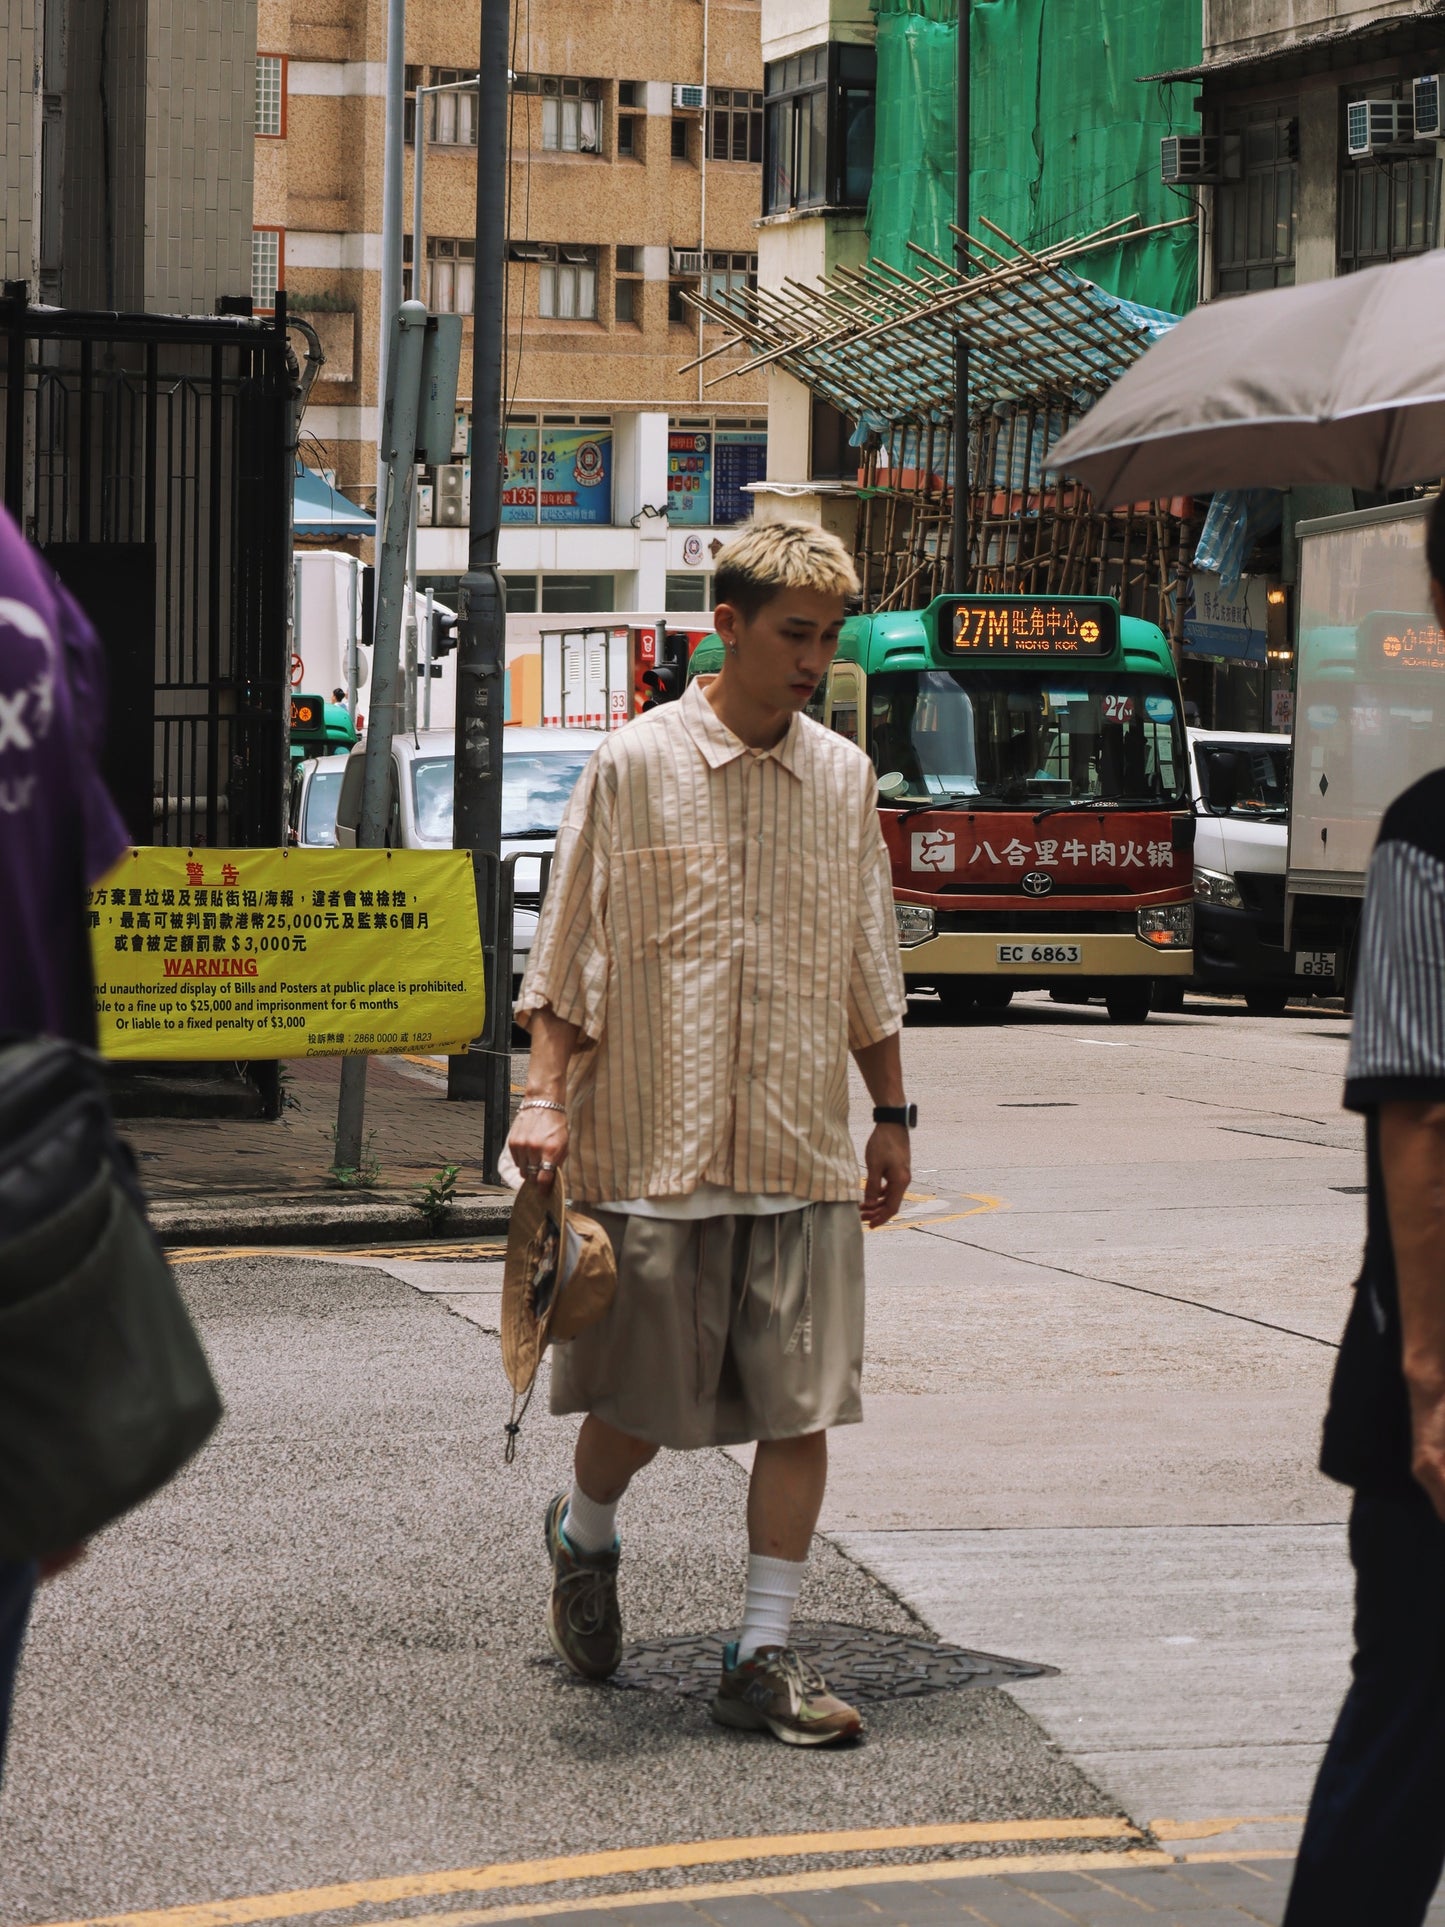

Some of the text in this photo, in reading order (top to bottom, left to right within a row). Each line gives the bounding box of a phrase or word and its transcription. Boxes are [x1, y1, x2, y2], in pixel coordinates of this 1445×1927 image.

[520, 450, 556, 464] 2024
[955, 607, 1008, 647] 27M
[1015, 640, 1078, 650] MONG KOK
[612, 695, 625, 708] 33
[968, 838, 1174, 868] 八合里牛肉火锅
[1000, 946, 1078, 962] EC 6863
[163, 958, 258, 977] WARNING
[1303, 961, 1334, 975] 835
[91, 980, 467, 997] nd unauthorized display of Bills and Posters at public place is prohibited.
[95, 998, 399, 1014] ble to a fine up to $25,000 and imprisonment for 6 months
[115, 1016, 306, 1031] Or liable to a fixed penalty of $3,000
[353, 1034, 374, 1043] 2868
[377, 1033, 398, 1043] 0000
[400, 1033, 409, 1043] 或
[412, 1033, 432, 1042] 1823
